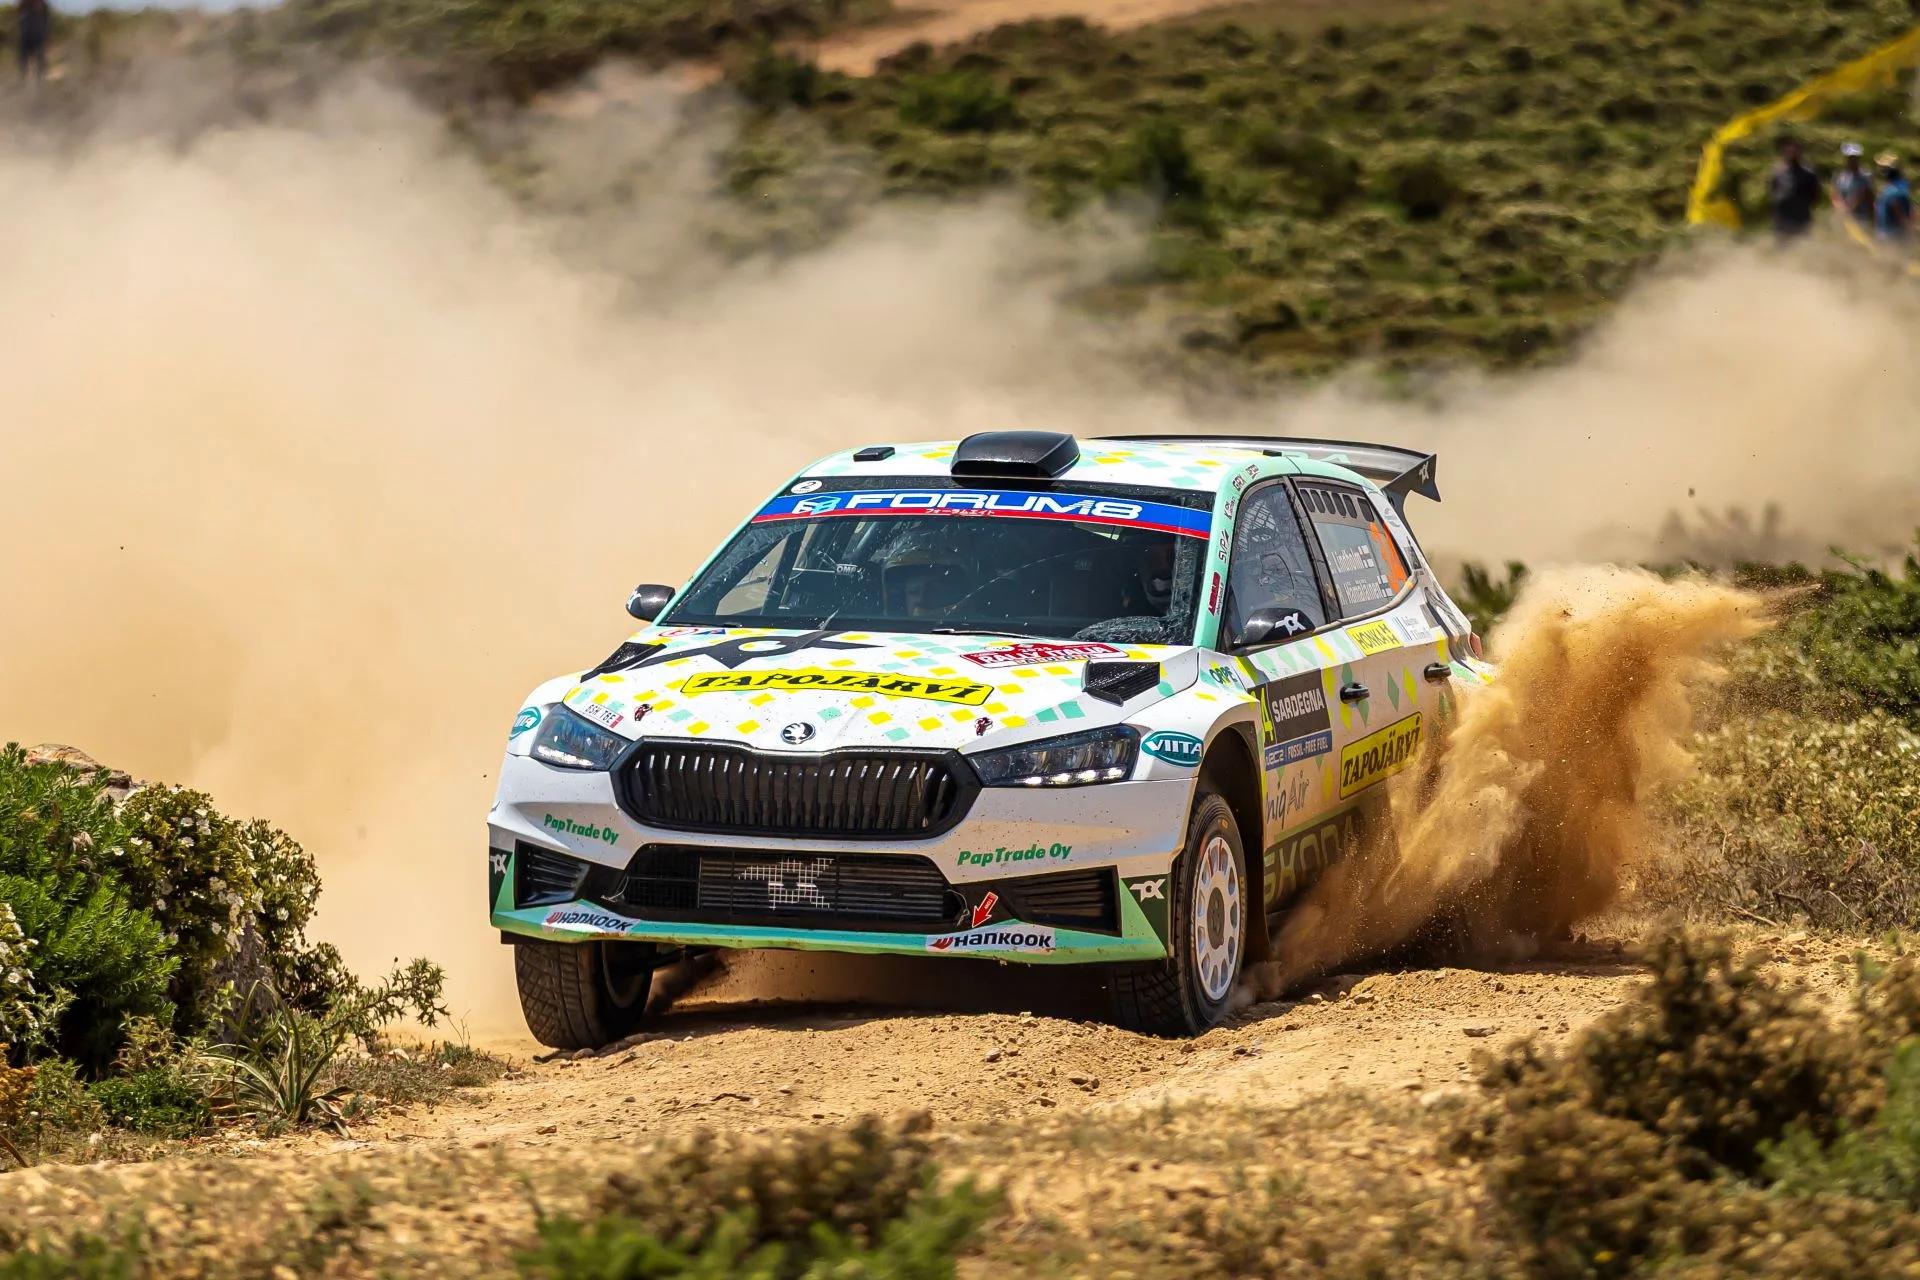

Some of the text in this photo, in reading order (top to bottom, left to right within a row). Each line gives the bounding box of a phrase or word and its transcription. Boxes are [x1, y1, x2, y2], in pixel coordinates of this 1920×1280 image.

[845, 494, 1142, 520] FORUM8
[977, 646, 1115, 664] RALLY ITALIA
[1272, 688, 1325, 723] SARDEGNA
[1146, 738, 1202, 757] VIITA
[1343, 716, 1421, 787] TAPOJÄRVI
[544, 814, 619, 845] PapTrade Oy
[958, 843, 1072, 867] PapTrade Oy
[954, 932, 1052, 948] Hankook
